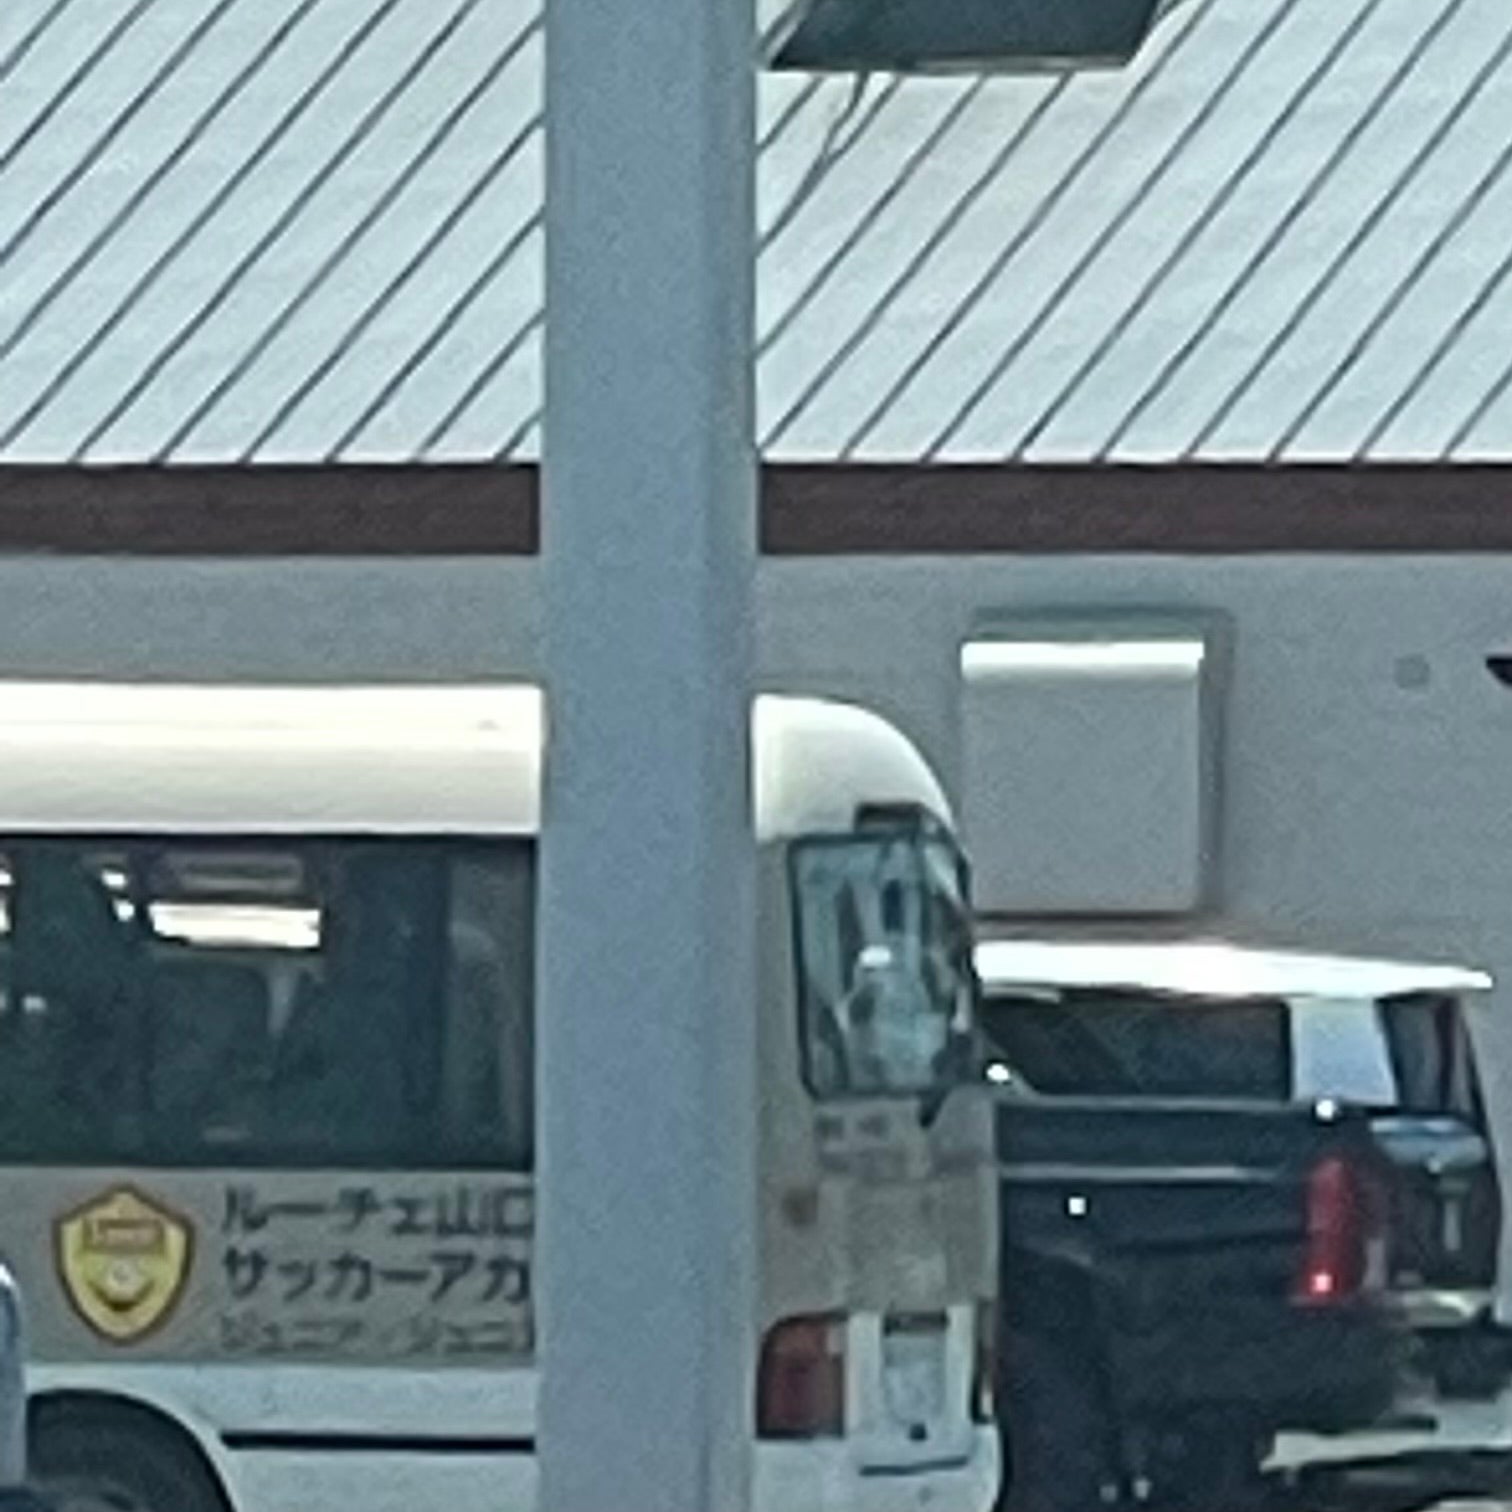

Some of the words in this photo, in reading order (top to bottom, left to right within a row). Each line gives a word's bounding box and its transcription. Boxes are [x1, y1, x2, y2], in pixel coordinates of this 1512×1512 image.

[222, 1184, 534, 1237] ルーチェ山口
[222, 1246, 530, 1304] サッカーアカ
